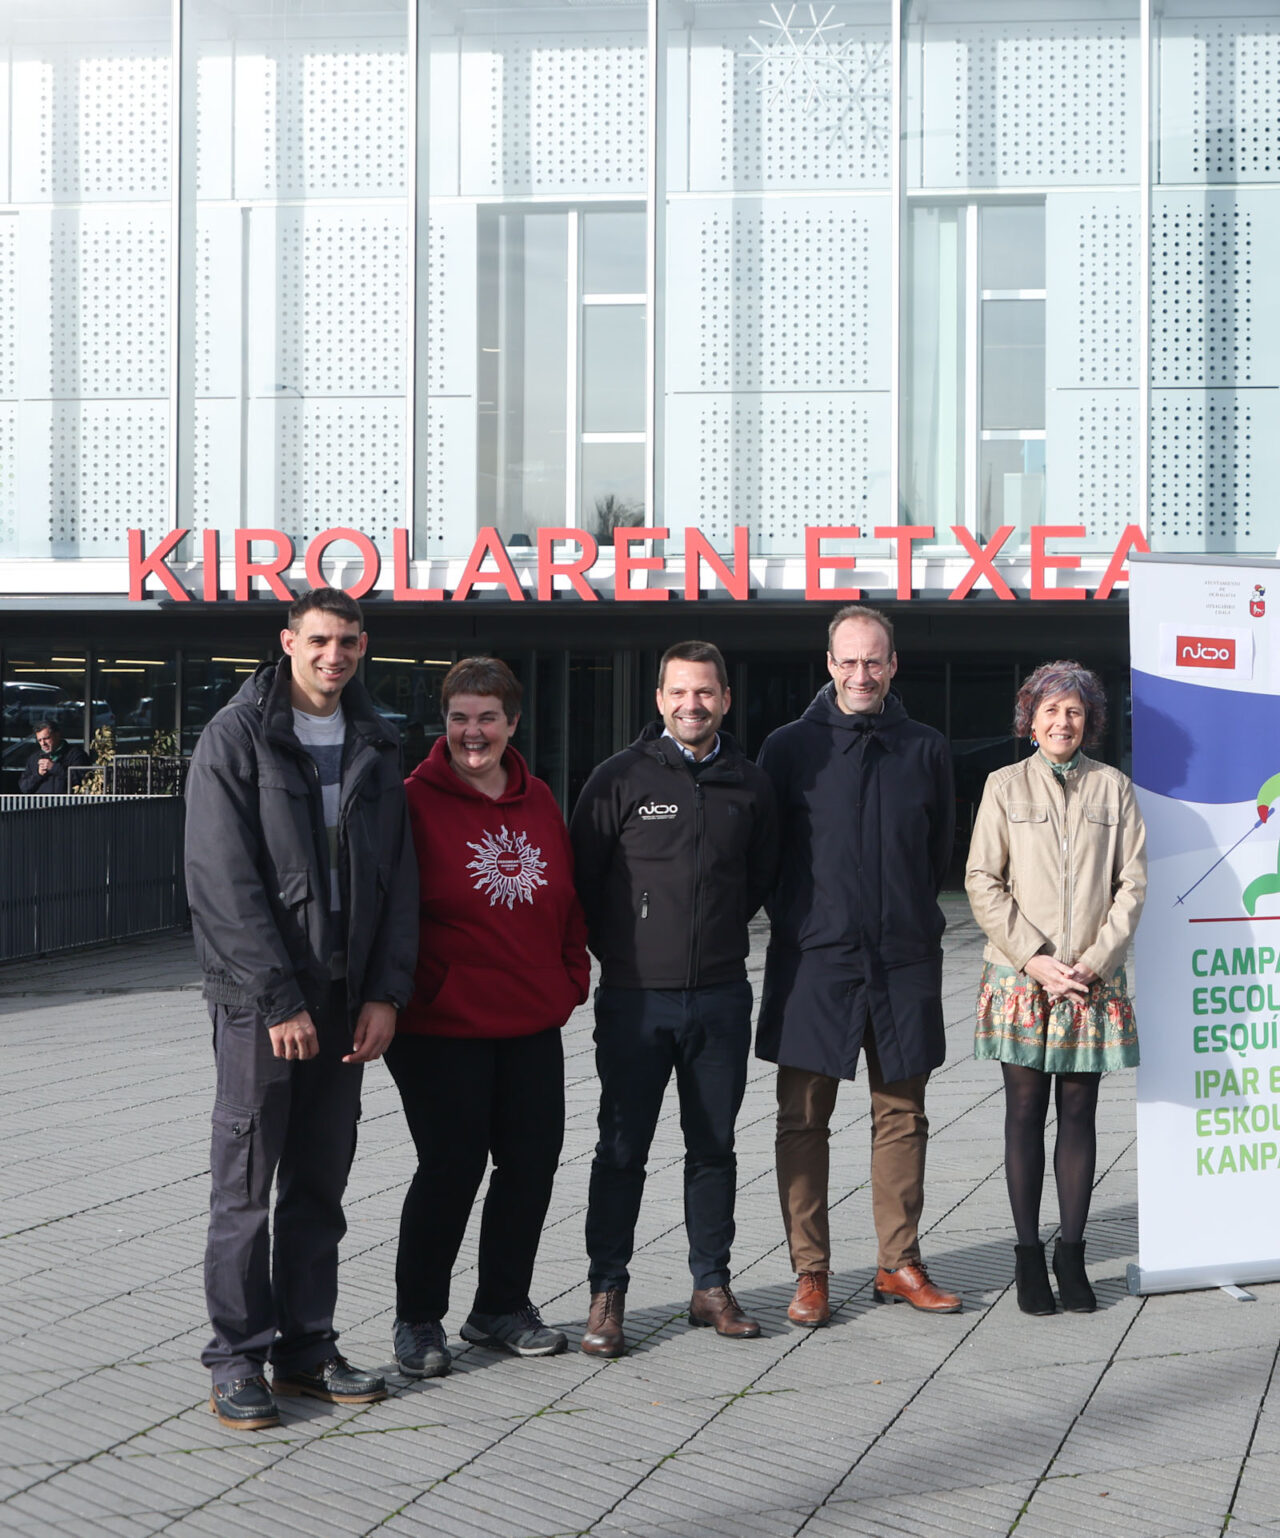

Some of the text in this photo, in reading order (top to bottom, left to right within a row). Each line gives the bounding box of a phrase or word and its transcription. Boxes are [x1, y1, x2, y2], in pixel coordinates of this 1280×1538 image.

[128, 524, 1152, 602] KIROLAREN ETXEA
[1193, 1014, 1278, 1057] ESQUÍ
[1195, 1067, 1260, 1099] IPAR
